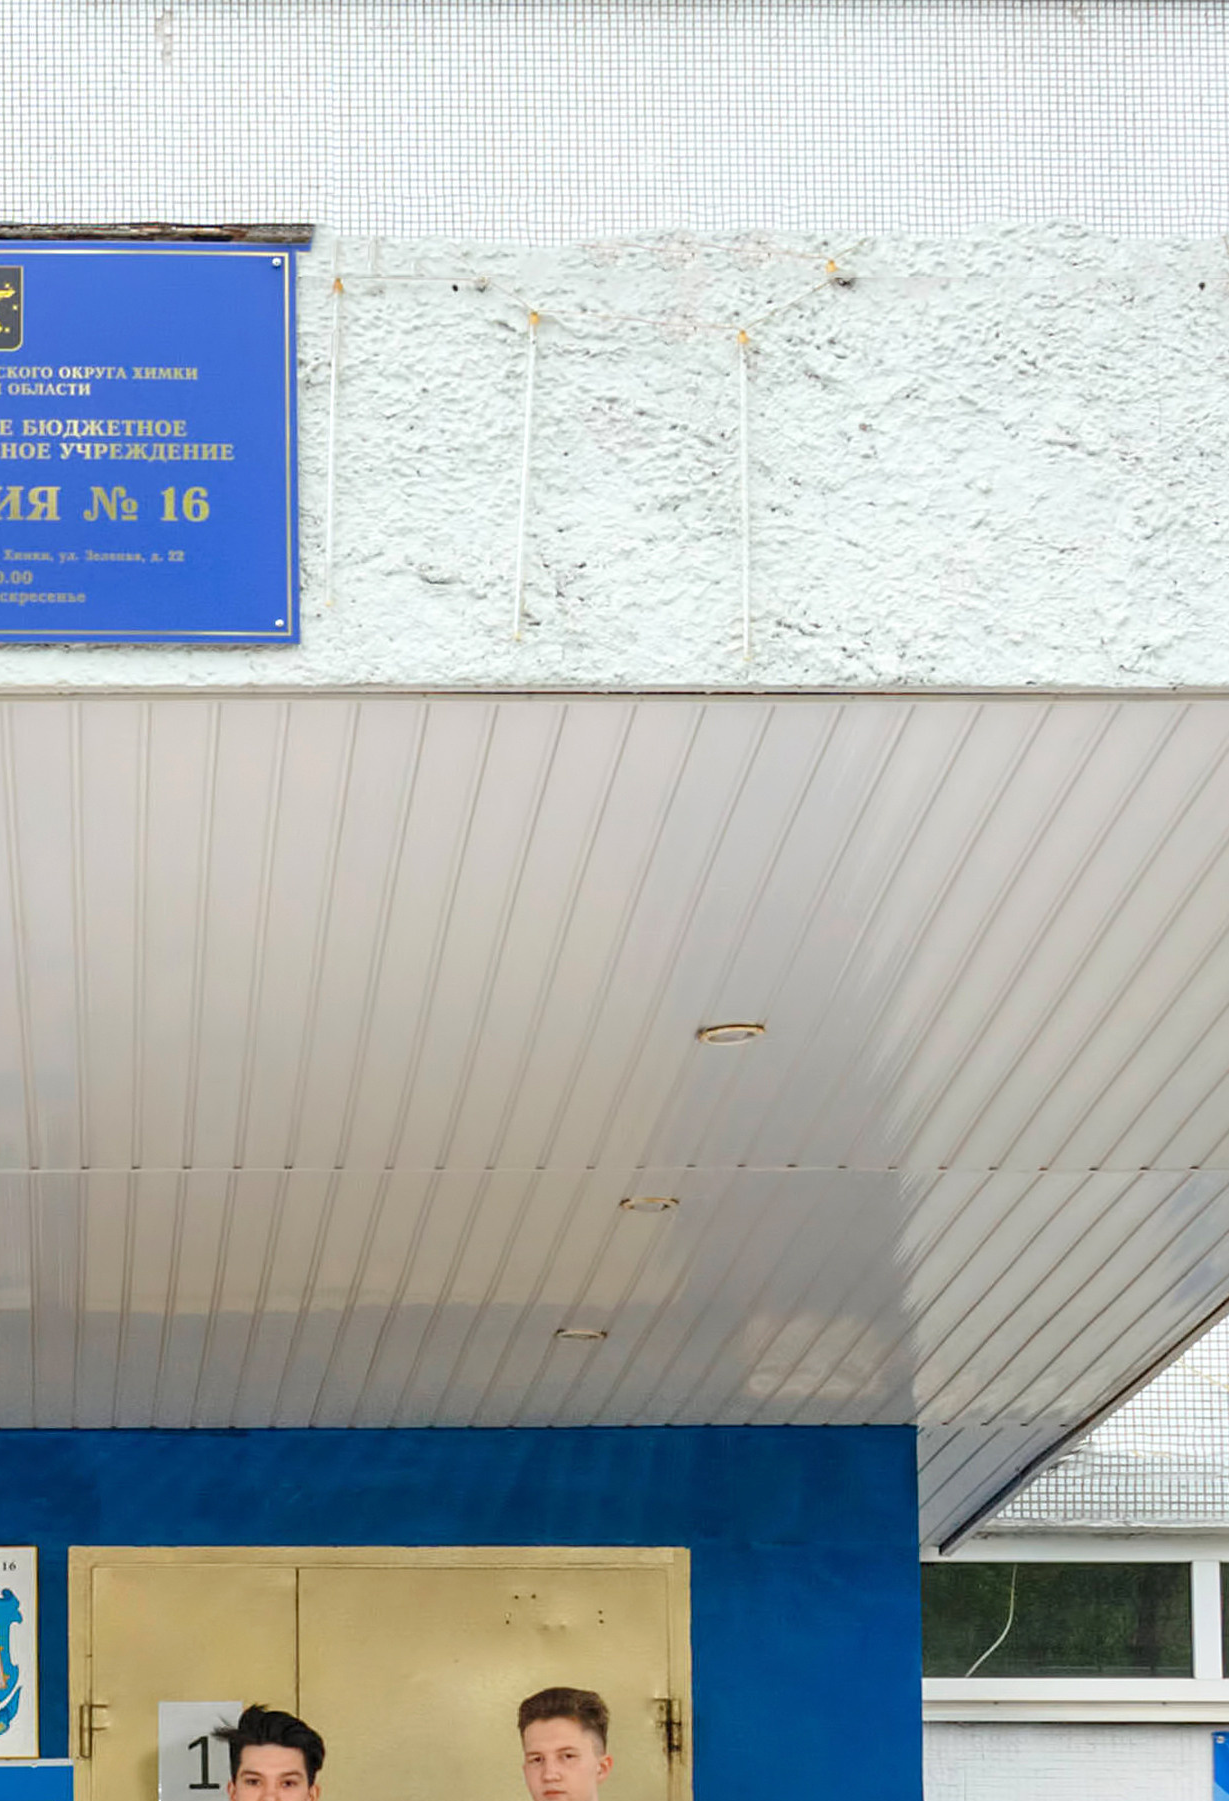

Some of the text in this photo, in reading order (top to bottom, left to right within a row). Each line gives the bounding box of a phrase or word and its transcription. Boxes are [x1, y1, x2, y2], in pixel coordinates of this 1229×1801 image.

[58, 366, 127, 381] ОКРУГА
[132, 366, 198, 381] ХИМКИ
[7, 382, 91, 397] ОБЛАСТИ
[22, 418, 187, 440] БЮДЖЕТНОЕ
[59, 443, 235, 462] УЧРЕЖДЕНИЕ
[83, 485, 139, 522] №
[160, 486, 210, 523] 16
[3, 549, 54, 563] Химки,
[58, 552, 79, 564] ул.
[188, 1735, 220, 1790] 1
